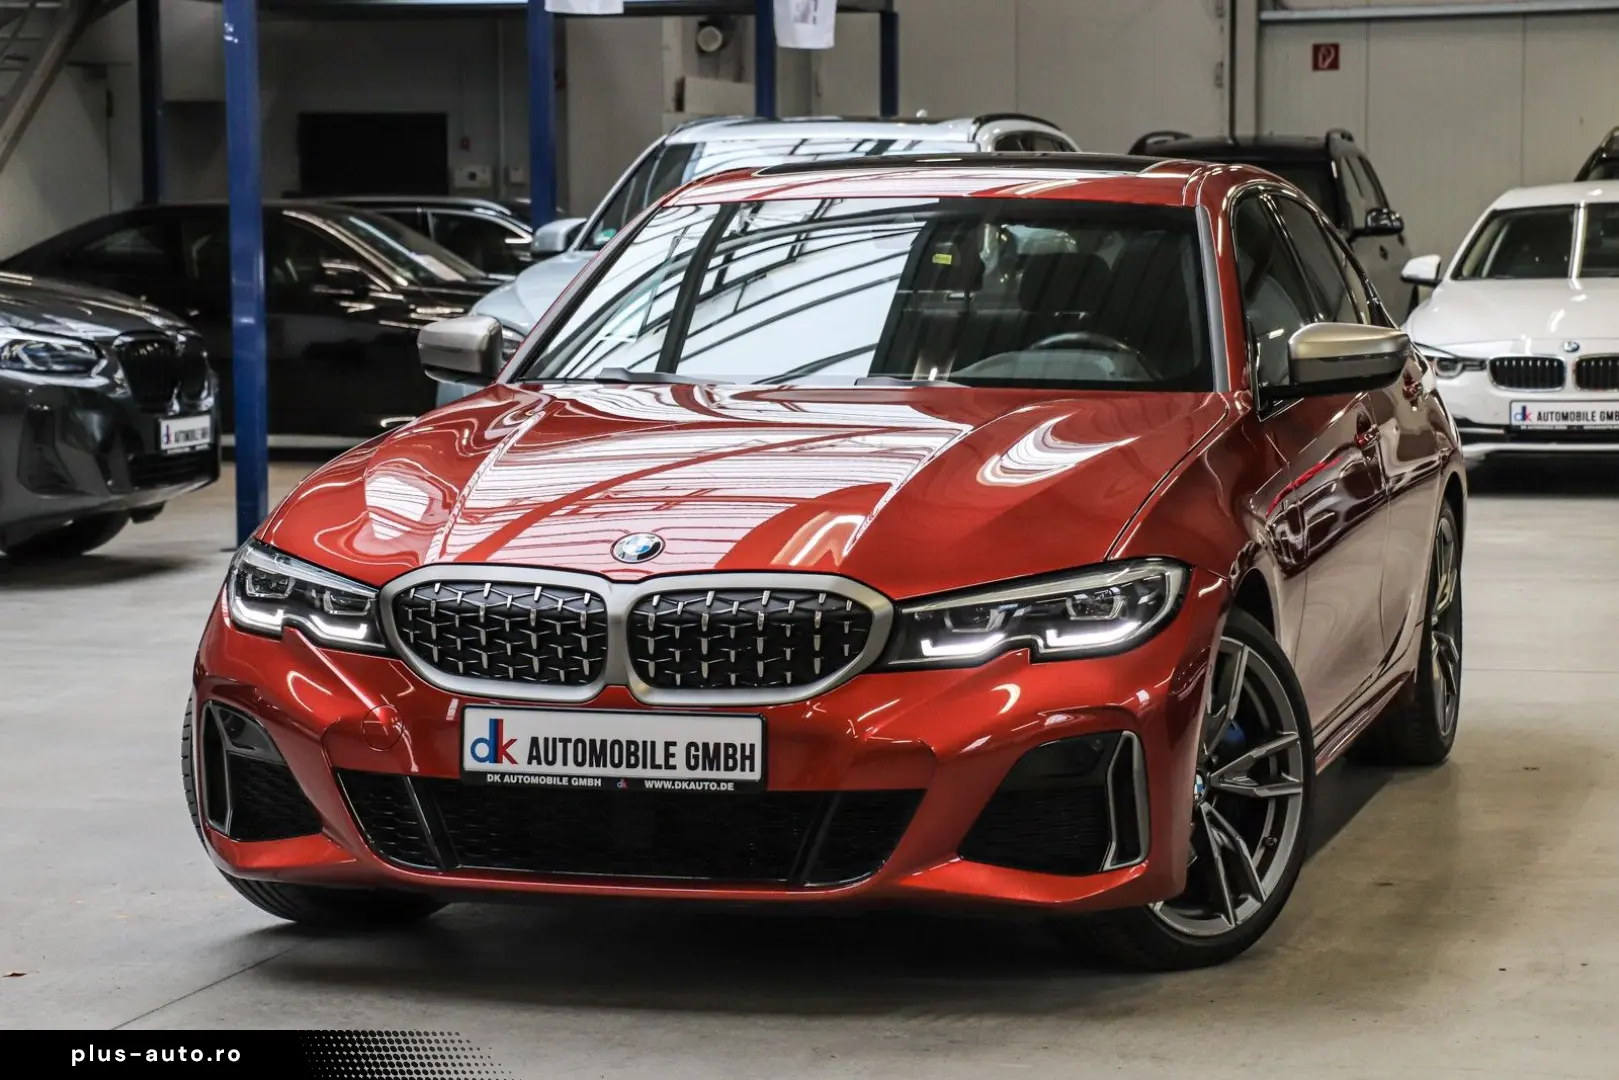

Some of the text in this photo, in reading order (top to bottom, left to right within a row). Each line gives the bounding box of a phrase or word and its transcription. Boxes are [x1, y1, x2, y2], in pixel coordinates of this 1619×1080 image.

[1514, 405, 1532, 421] dk
[1537, 411, 1596, 422] AUTOMOBILE
[470, 718, 755, 772] dk AUTOMOBILE GMBH
[487, 774, 602, 786] DK AUTOMOBILE GMBH
[644, 780, 734, 791] WWW.DKAUTO.DE
